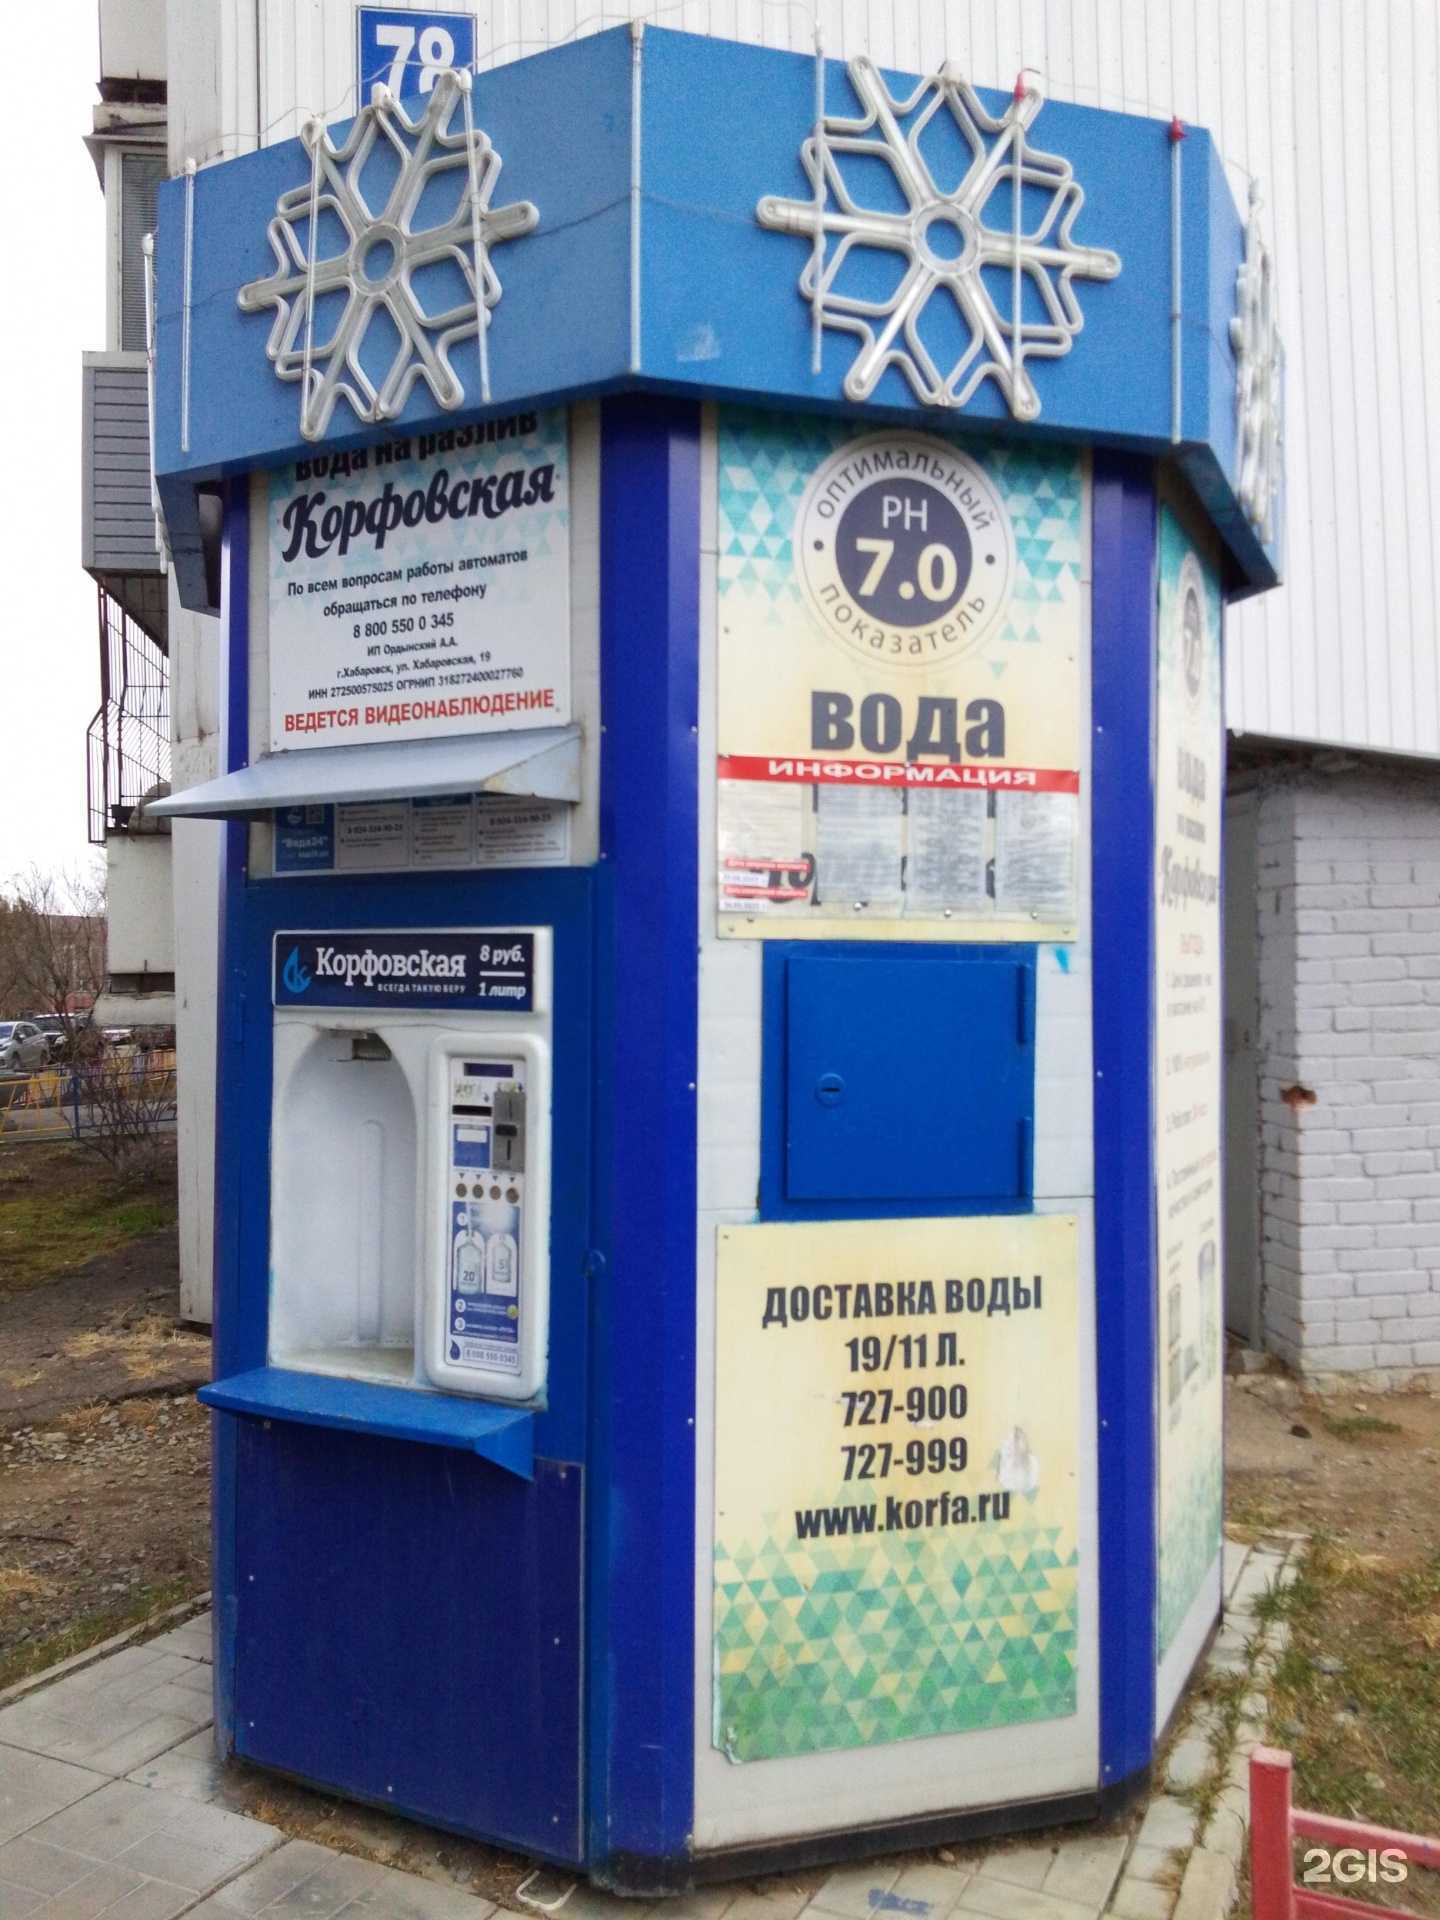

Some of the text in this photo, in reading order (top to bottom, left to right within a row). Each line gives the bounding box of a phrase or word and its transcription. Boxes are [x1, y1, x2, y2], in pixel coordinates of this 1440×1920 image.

[376, 24, 455, 101] 78
[281, 464, 555, 562] Корфовская
[287, 549, 528, 596] По всем вопросам работы автоматов
[855, 537, 958, 602] 7.0
[323, 582, 487, 618] обращаться по телефону
[353, 612, 455, 639] 8 800 550 0 345
[367, 645, 381, 657] ИП
[308, 687, 328, 701] ИНН
[330, 679, 394, 698] 272500575025
[396, 677, 436, 691] ОГРНИП
[284, 688, 555, 733] ВЕДЕТСЯ ВИДЕОНАБЛЮДЕНИЕ
[811, 690, 1006, 763] вода
[768, 758, 1037, 786] ИНФОРМАЦИЯ
[315, 947, 467, 986] Корфовская
[479, 944, 525, 965] 8 руб.
[377, 983, 467, 993] ВСЕГДА ТАКУЮ БЕРУ
[478, 982, 527, 1000] 1 литр
[463, 1270, 475, 1282] 20
[762, 1275, 1042, 1329] ДОСТАВКА ВОДЫ
[844, 1334, 928, 1373] 19/11
[841, 1384, 968, 1427] 727-900
[841, 1437, 968, 1481] 727-999
[795, 1491, 1011, 1540] www.korfa.ru
